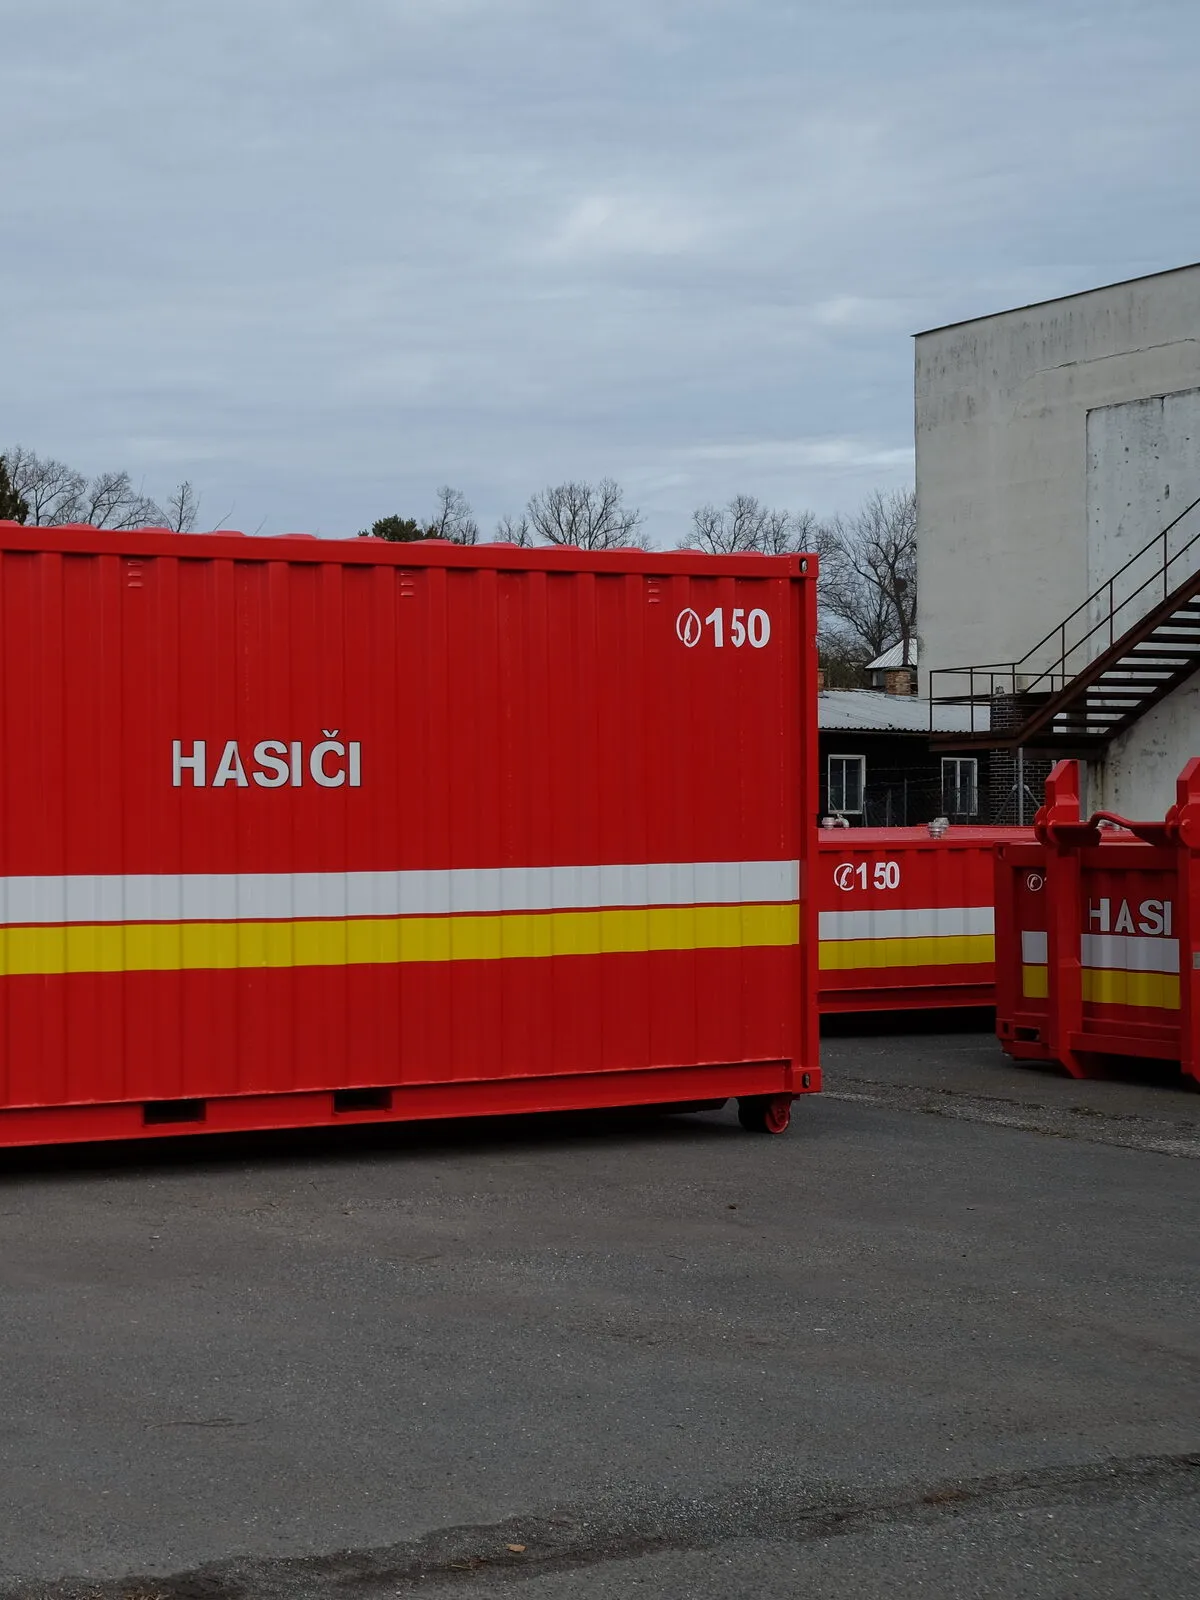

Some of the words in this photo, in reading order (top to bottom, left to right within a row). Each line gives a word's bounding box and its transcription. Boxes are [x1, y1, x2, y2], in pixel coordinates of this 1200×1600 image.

[704, 606, 772, 649] 150
[171, 728, 363, 788] HASIČI
[855, 860, 901, 891] 150
